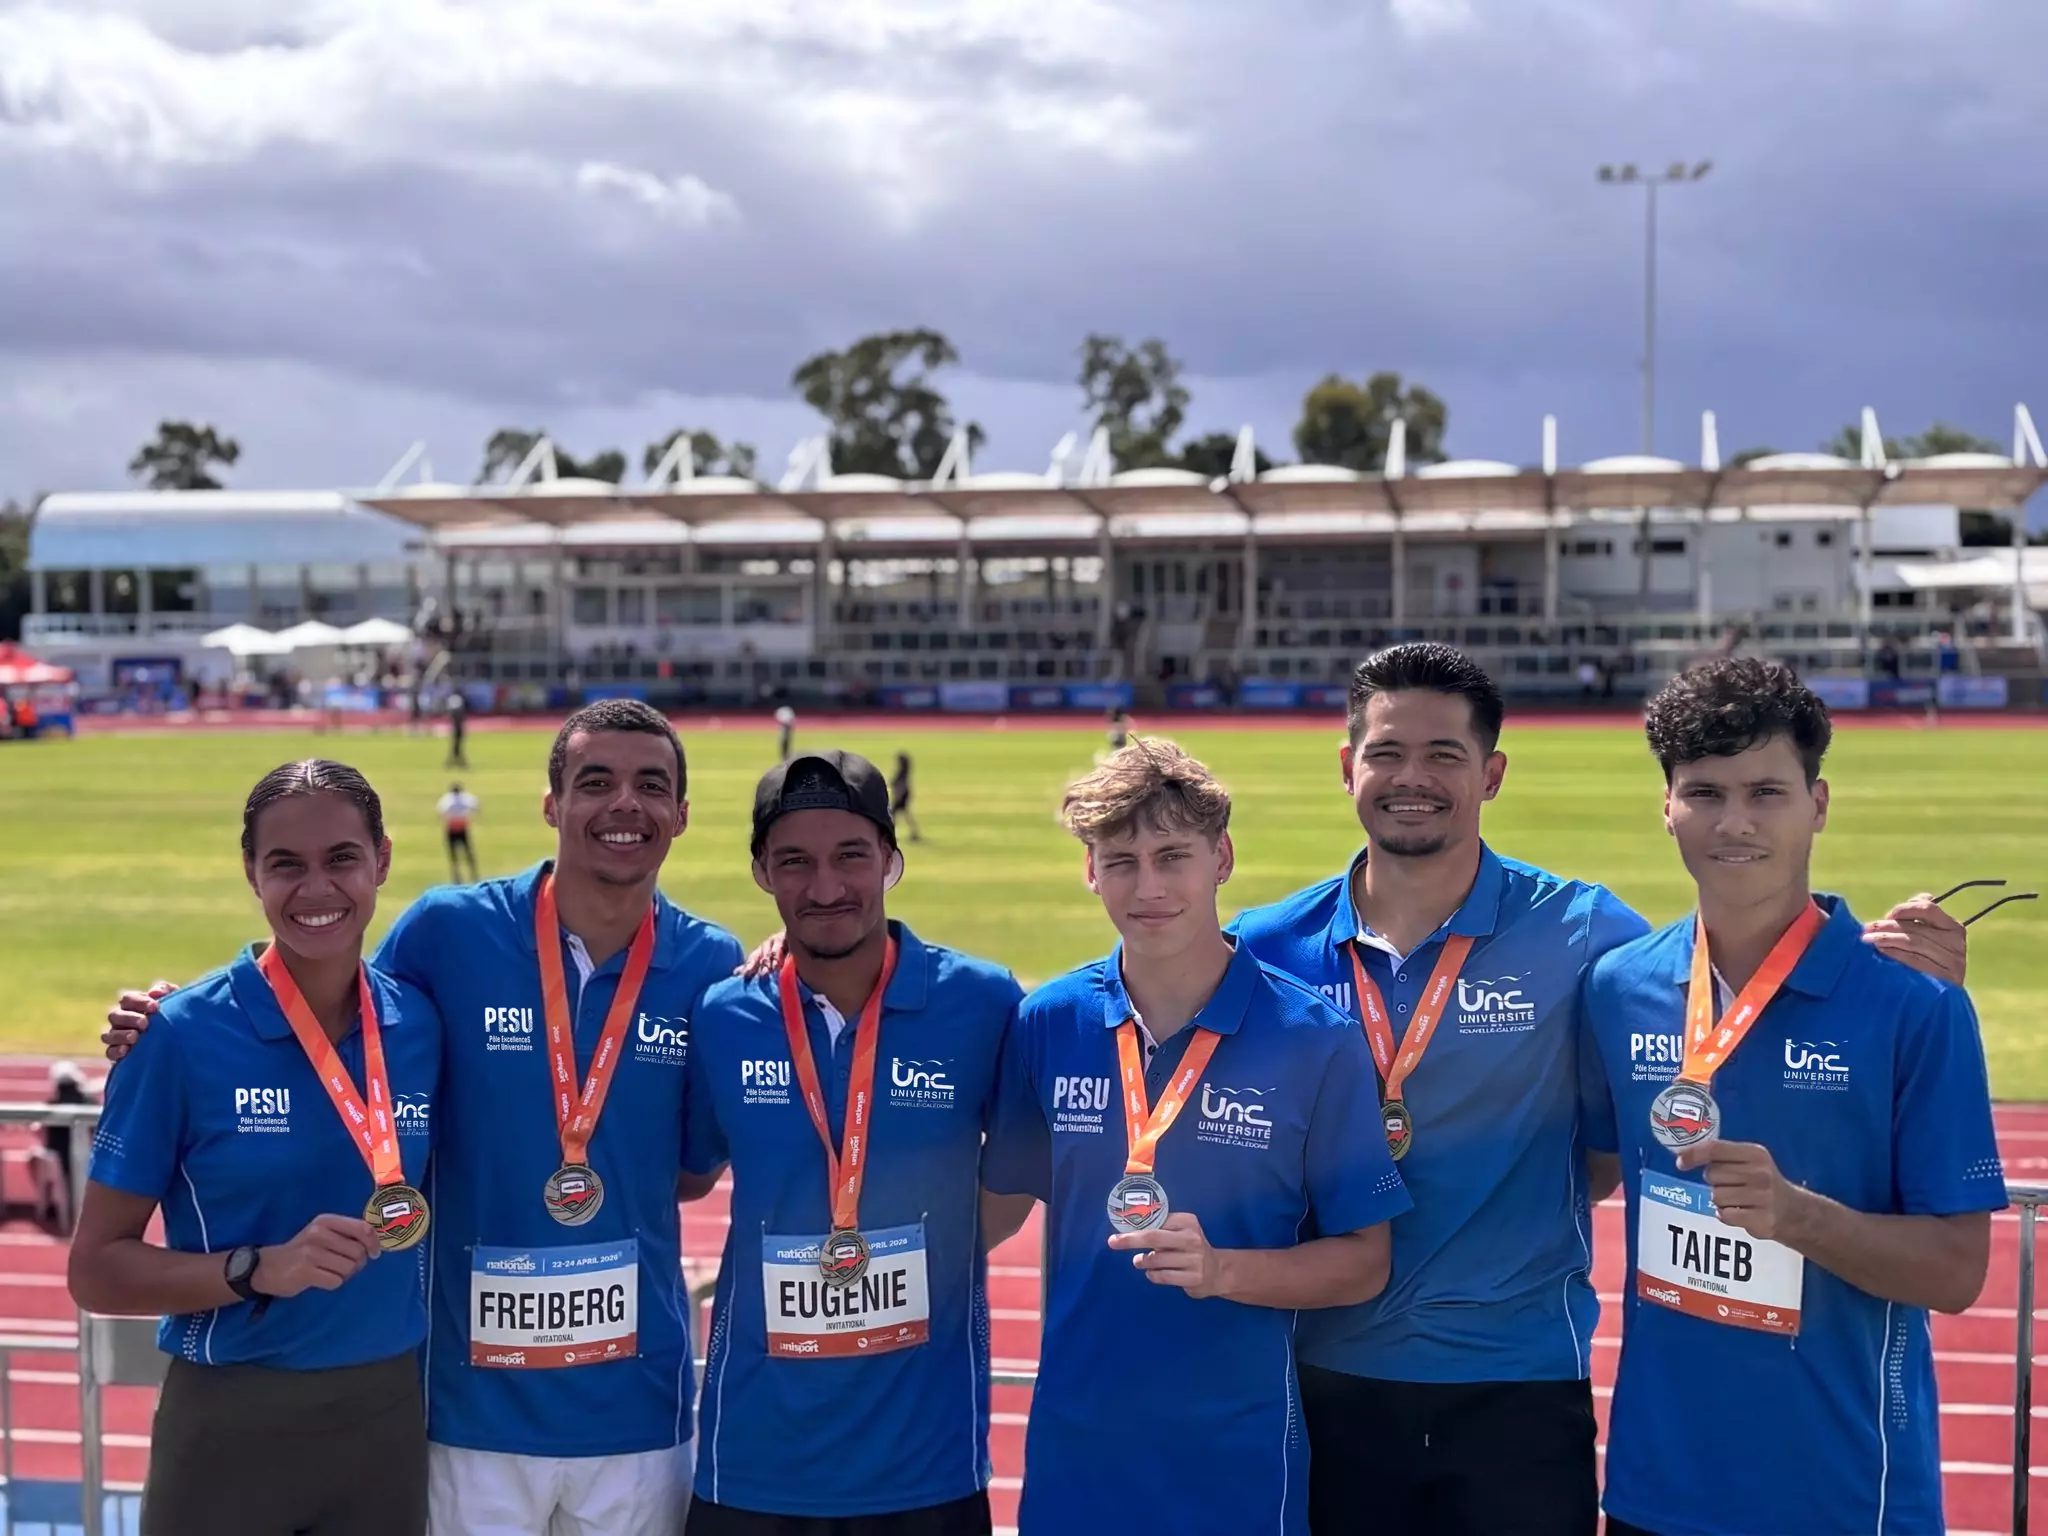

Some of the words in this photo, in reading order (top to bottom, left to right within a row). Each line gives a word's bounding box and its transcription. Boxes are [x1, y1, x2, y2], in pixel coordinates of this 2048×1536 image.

[485, 1007, 533, 1033] PESU
[1458, 1009, 1535, 1024] UNIVERSITÉ
[489, 1035, 501, 1043] Pôle
[486, 1043, 501, 1052] Sport
[501, 1043, 533, 1051] Universitaire
[636, 1043, 687, 1057] UNIVERSI
[1630, 1033, 1683, 1063] PESU
[741, 1060, 790, 1086] PESU
[1632, 1072, 1647, 1081] Sport
[1648, 1073, 1676, 1081] Universit
[1783, 1071, 1849, 1082] UNIVERSITÉ
[891, 1089, 954, 1100] UNIVERSITÉ
[1053, 1076, 1110, 1110] PESU
[235, 1088, 291, 1115] PESU
[743, 1096, 758, 1104] Sport
[758, 1096, 790, 1104] Universitaire
[240, 1117, 253, 1125] Pôle
[254, 1117, 288, 1125] ExcellenceS
[397, 1120, 429, 1128] IVERSI
[237, 1124, 254, 1133] Sport
[254, 1125, 290, 1133] Universitaire
[850, 1135, 860, 1166] unisport
[856, 1091, 865, 1125] nationals
[1198, 1121, 1271, 1139] UNIVERSITÉ
[1650, 1184, 1692, 1205] nationals
[869, 1240, 888, 1250] PRIL
[889, 1238, 908, 1248] 2026
[777, 1248, 819, 1259] national
[1667, 1223, 1753, 1283] TAIEB
[486, 1258, 536, 1271] nationals
[552, 1260, 575, 1268] 22-24
[577, 1258, 599, 1266] APRIL
[1687, 1276, 1729, 1294] INVITATIONAL
[780, 1269, 907, 1318] EUGENIE
[1646, 1286, 1681, 1306] unisport
[480, 1284, 625, 1330] FREIBERG
[825, 1319, 866, 1331] INVITATIONAL
[533, 1333, 574, 1343] INVITATIONAL
[780, 1340, 819, 1354] unisport
[487, 1353, 526, 1366] unisport
